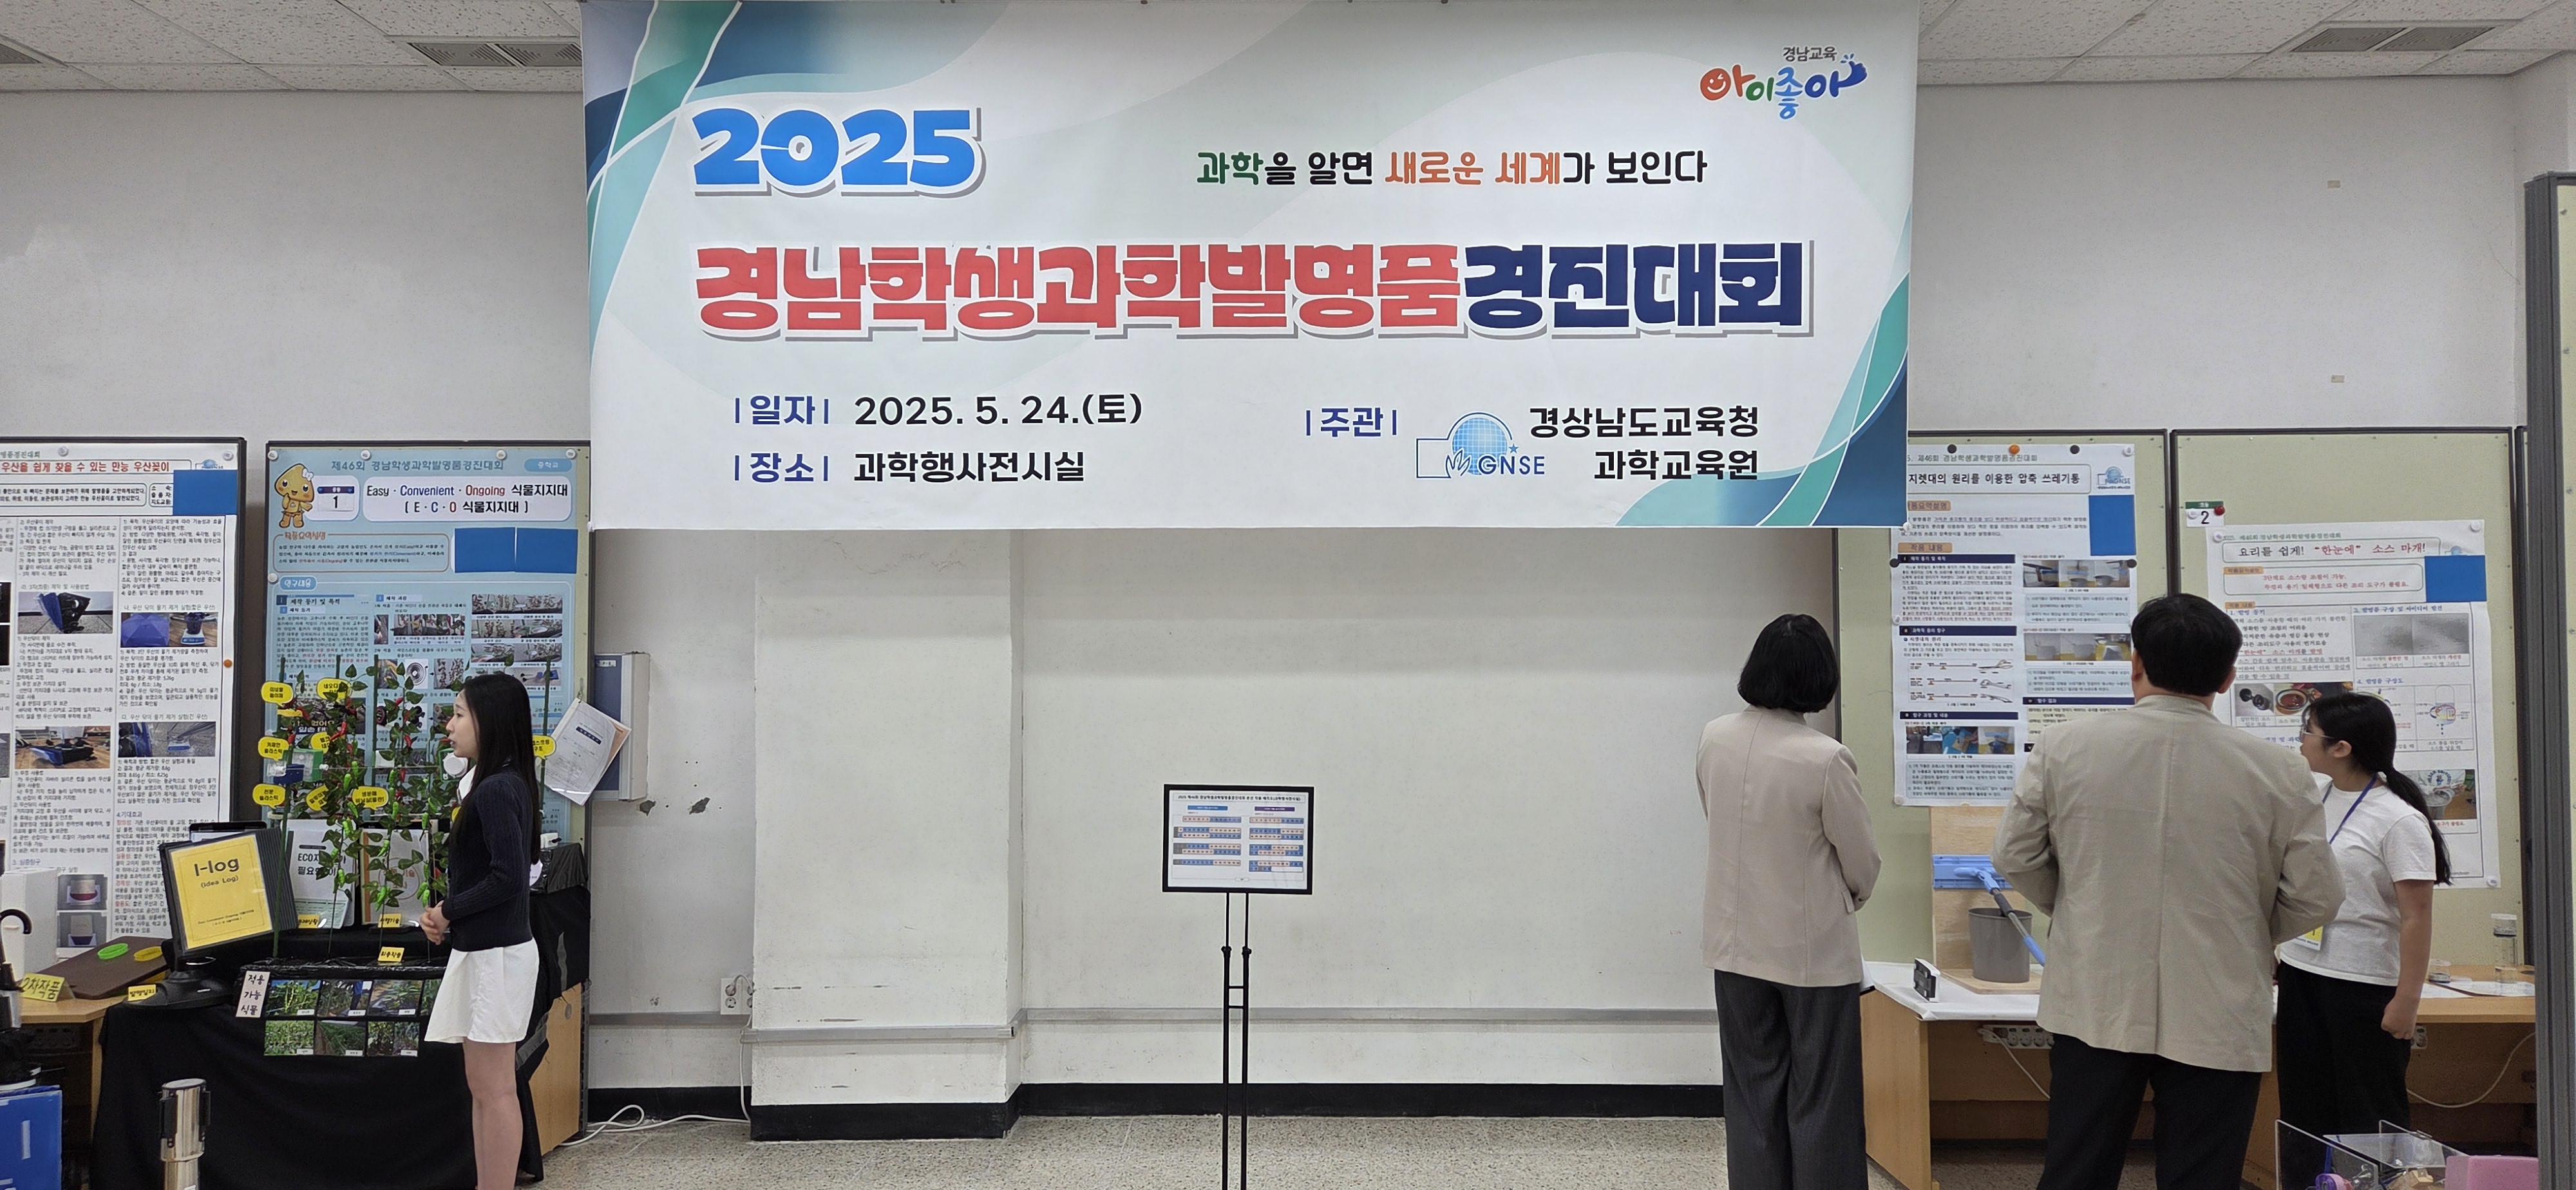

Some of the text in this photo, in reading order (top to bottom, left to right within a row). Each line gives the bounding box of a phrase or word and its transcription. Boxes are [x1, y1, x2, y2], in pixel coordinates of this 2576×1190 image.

[1783, 46, 1843, 63] 경남교육
[1700, 61, 1864, 119] 아이좋아
[693, 108, 981, 194] 2025
[1197, 151, 1707, 185] 과학을 알면 새로운 세계가 보인다
[696, 242, 1805, 331] 경남학생과학발명품경진대회
[854, 392, 1143, 426] 2025. 5. 24.(토)
[1529, 406, 1758, 438] 경상남도교육청
[2, 461, 169, 472] 우산을 쉽게 찾을 수 있는 만능 우산꽂이
[331, 460, 505, 472] 제46회 경남학생과학발명품경진대회
[854, 451, 1085, 484] 과학행사전시실
[1478, 453, 1546, 477] GNSE
[1594, 449, 1758, 480] 과학교육원
[1909, 473, 2079, 484] 지렛대의 원리를 이용한 압축 쓰레기통
[366, 484, 568, 496] Easy Convenient Ongoing 식물지지대
[332, 495, 339, 509] 1
[462, 501, 519, 513] 식물지지대
[2201, 511, 2210, 524] 2
[1910, 543, 1943, 552] 작품 내용
[2239, 547, 2271, 557] 요리를
[2279, 546, 2304, 556] 쉽게!
[2372, 544, 2395, 553] 소스
[2401, 542, 2425, 553] 마개!
[200, 874, 239, 889] (Idea Log)
[248, 974, 265, 984] 적용
[22, 980, 59, 999] 2차작품
[244, 991, 261, 1000] 가능
[241, 1005, 258, 1016] 식물
